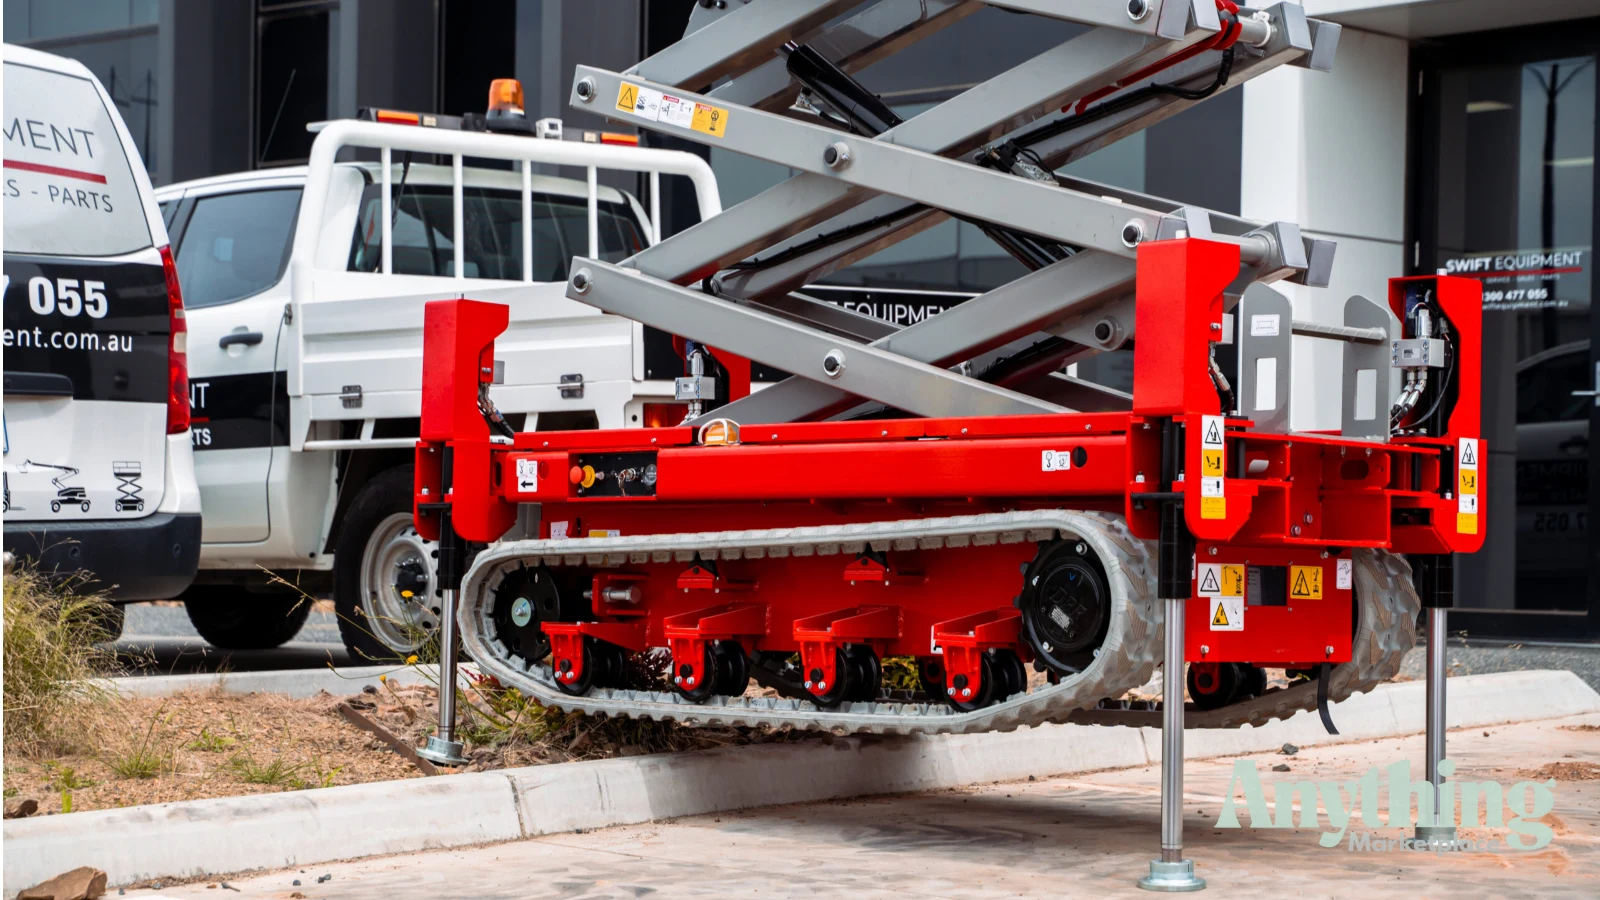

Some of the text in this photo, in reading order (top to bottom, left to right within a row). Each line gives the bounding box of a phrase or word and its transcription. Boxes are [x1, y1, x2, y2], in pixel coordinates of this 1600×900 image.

[3, 117, 95, 159] MENT
[3, 179, 20, 198] S
[48, 184, 114, 213] PARTS
[1445, 251, 1583, 272] SWIFT EQUIPMENT
[28, 276, 108, 318] 055
[1505, 289, 1526, 300] 477
[3, 326, 133, 352] ent.com.au
